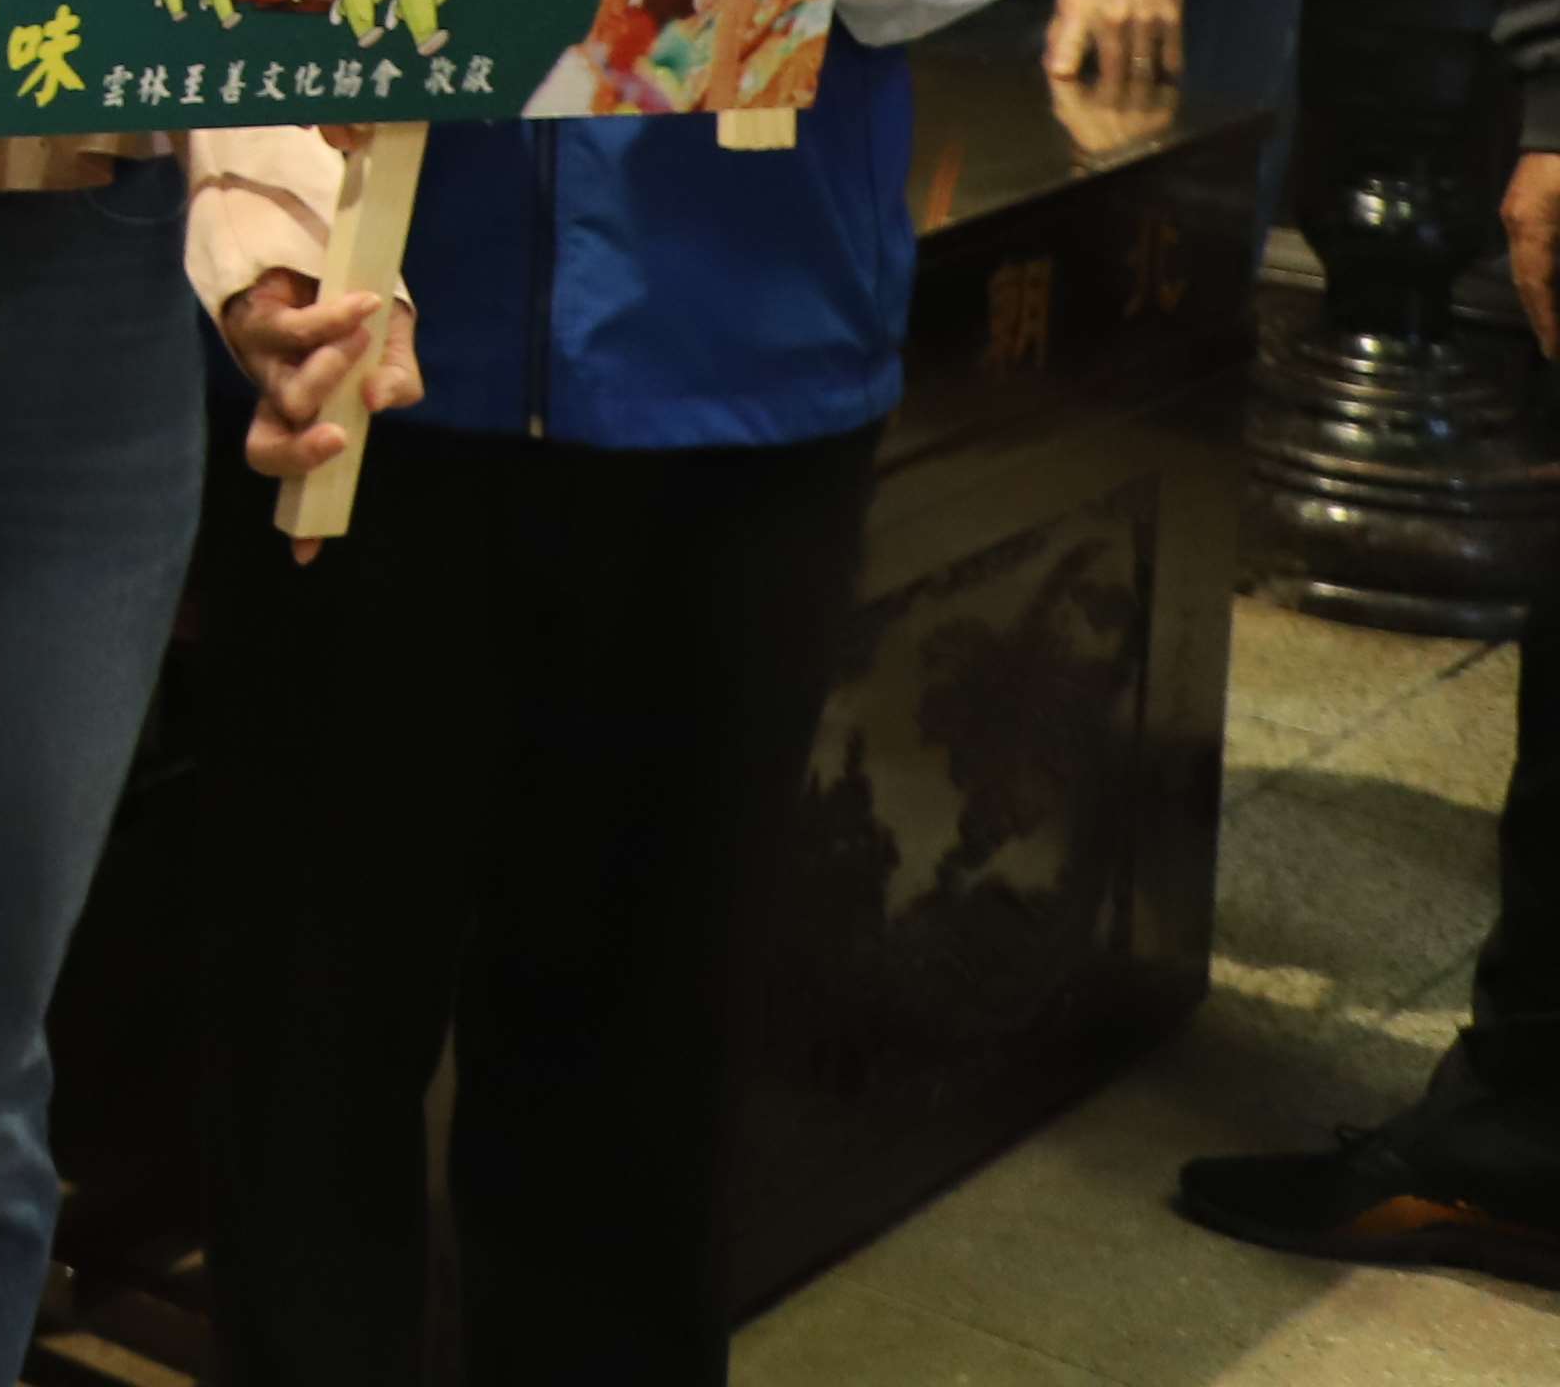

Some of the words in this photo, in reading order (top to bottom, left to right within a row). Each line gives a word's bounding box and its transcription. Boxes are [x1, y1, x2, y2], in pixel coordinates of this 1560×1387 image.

[102, 59, 403, 108] 雲林至善文化協會
